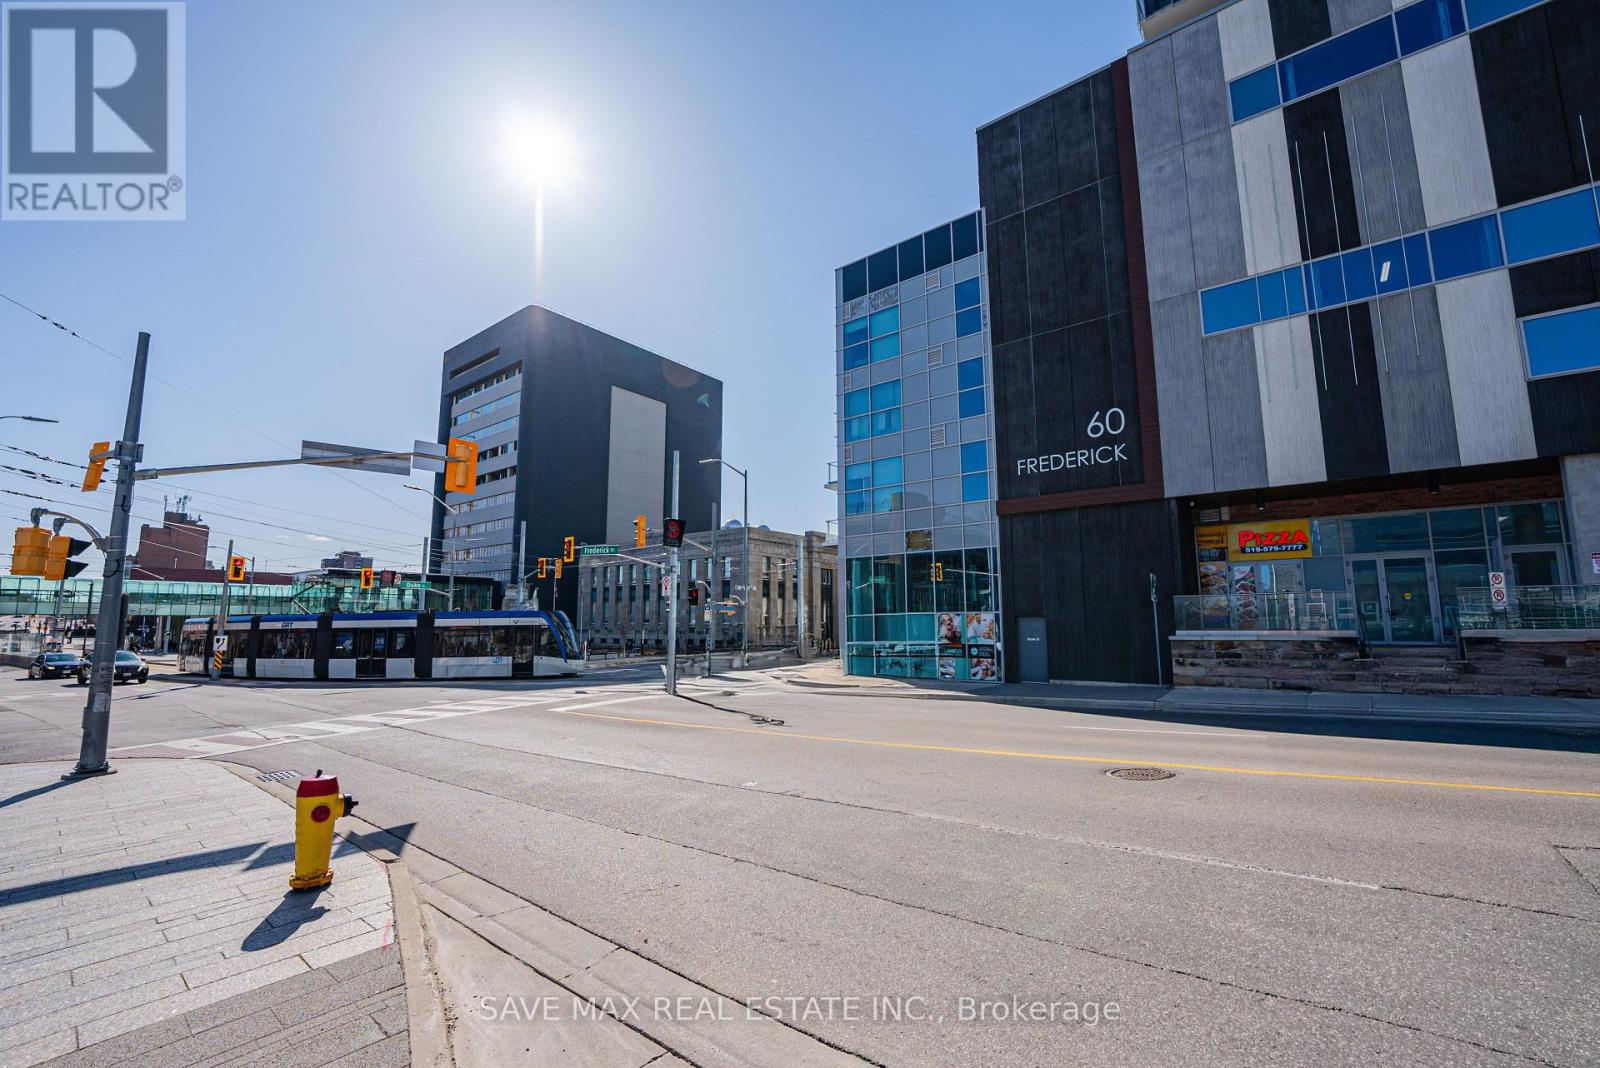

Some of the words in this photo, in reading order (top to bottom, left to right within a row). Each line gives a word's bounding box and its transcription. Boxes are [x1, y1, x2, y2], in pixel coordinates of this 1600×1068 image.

[1087, 407, 1126, 438] 60
[1017, 443, 1128, 476] FREDERICK
[584, 546, 609, 554] Frederick
[1238, 530, 1308, 548] PIZZA
